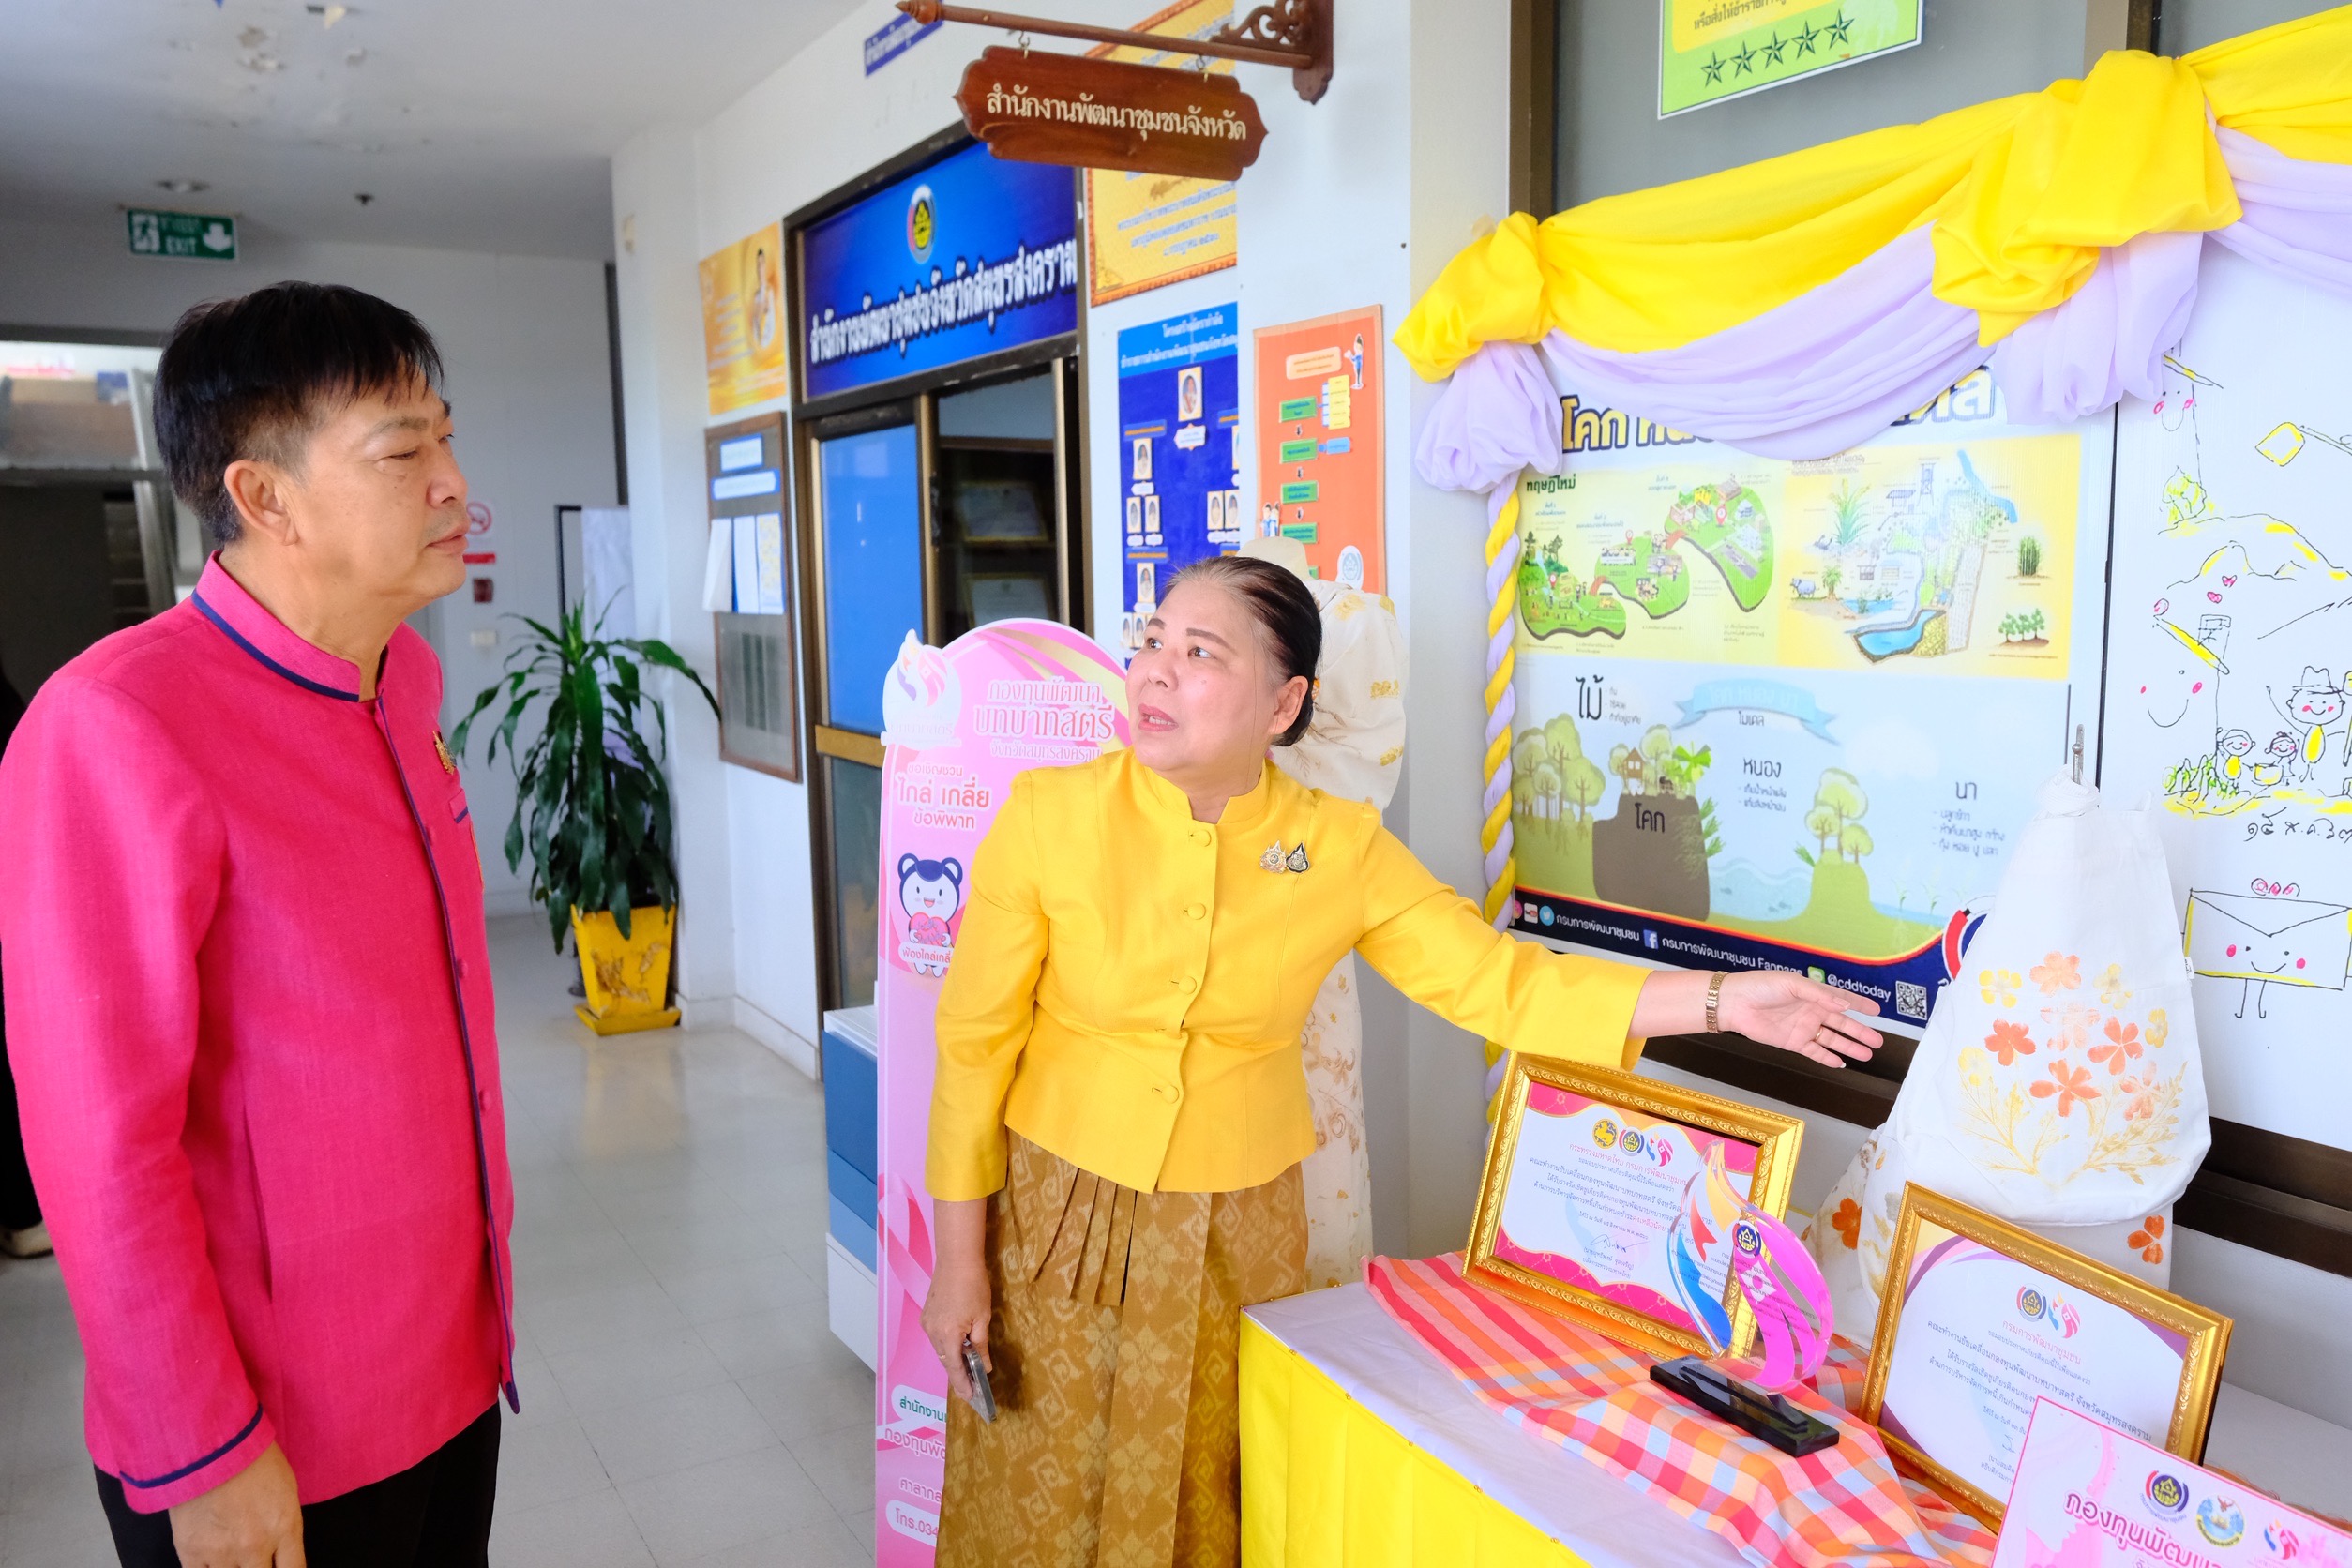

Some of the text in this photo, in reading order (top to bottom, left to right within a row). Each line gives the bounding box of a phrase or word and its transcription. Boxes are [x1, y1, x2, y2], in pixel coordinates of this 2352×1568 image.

[987, 83, 1246, 141] สำนักงานพัฒนาชุมชนจังหวัด
[1560, 394, 1629, 453] โคก
[988, 676, 1103, 706] กองทุนพัฒนา
[1576, 674, 1604, 720] ไม้
[975, 704, 1115, 740] บทบาทสตรี
[1743, 758, 1782, 778] หนอง
[897, 776, 989, 807] ไกล่ เกลี่ย
[1955, 781, 1977, 800] นา
[914, 808, 975, 829] ข้อพิพาท
[1635, 803, 1665, 833] โคก
[1556, 914, 1640, 941] กรมการพัฒนาชุมชน
[1662, 937, 1755, 968] กรมการพัฒนาชุมชน
[1827, 972, 1892, 1003] @cddtoday
[1569, 1142, 1688, 1186] กระทรวงมหาดไทย กรมการพัฒนาชุมชน
[2003, 1319, 2081, 1365] กรมการพัฒนาชุมชน
[2076, 1395, 2152, 1442] จังหวัดสมุทรสงคราม
